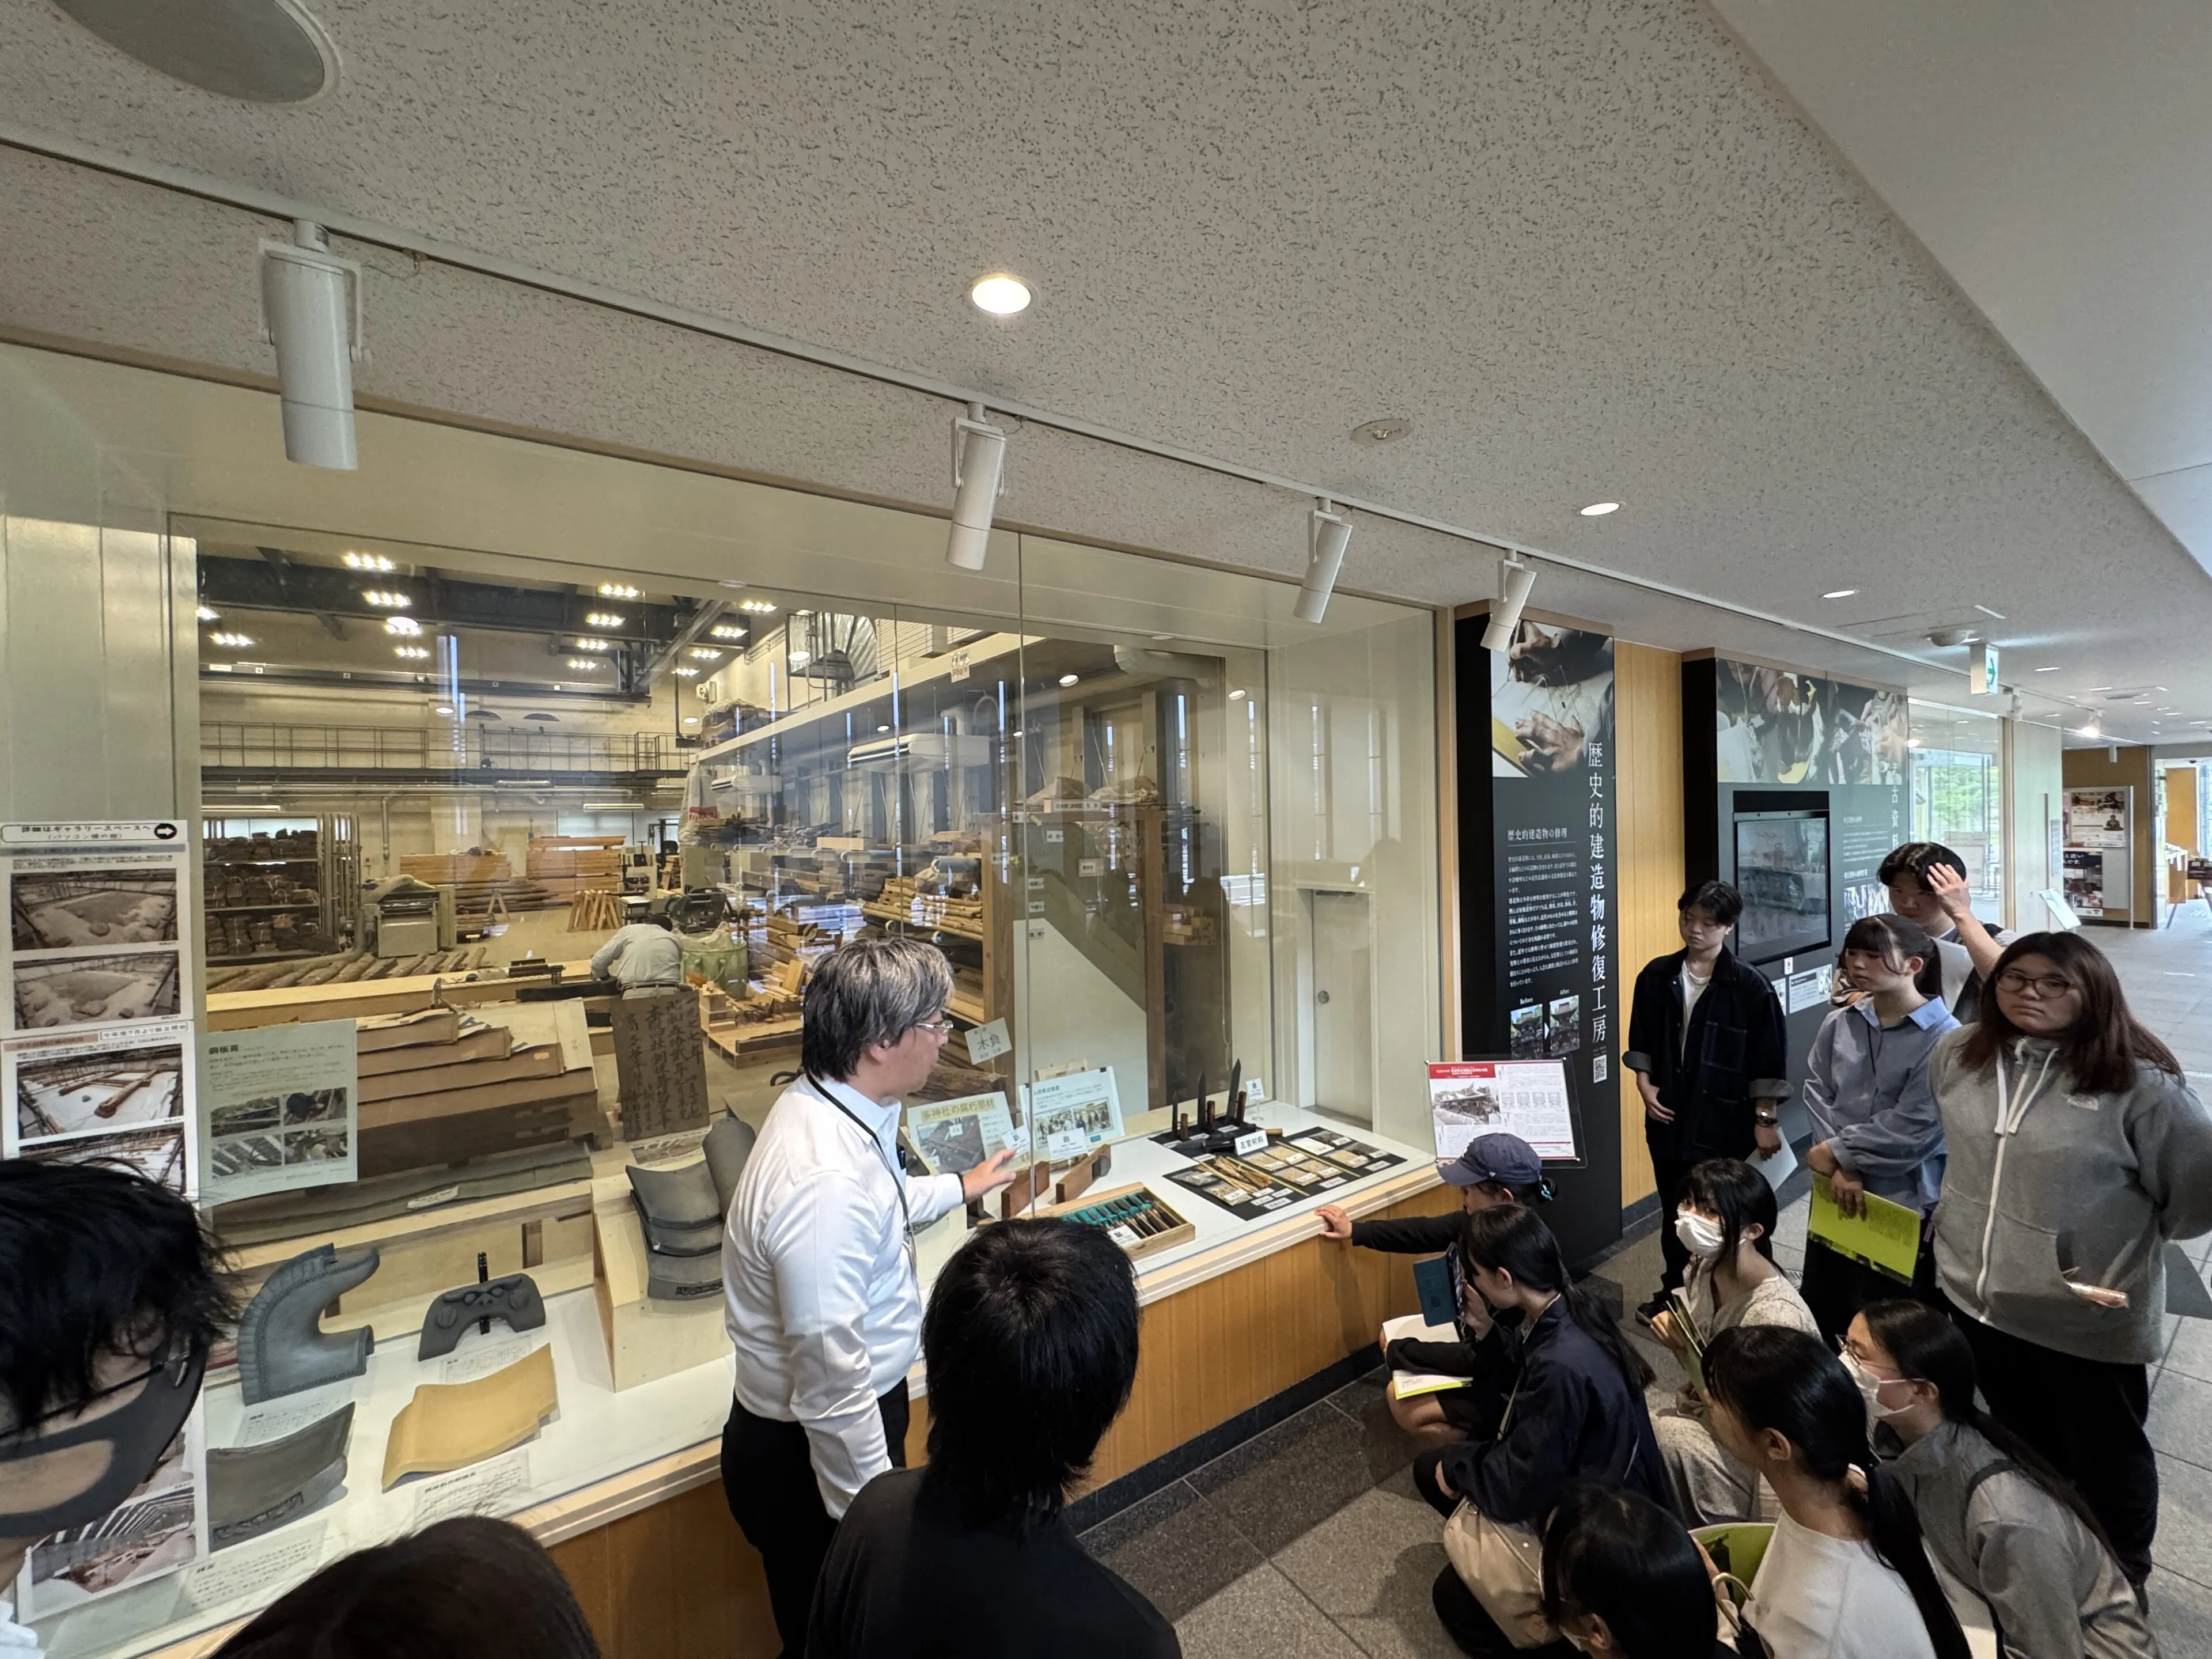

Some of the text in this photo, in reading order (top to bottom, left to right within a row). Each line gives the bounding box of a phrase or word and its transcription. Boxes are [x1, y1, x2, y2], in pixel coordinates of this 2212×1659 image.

[21, 825, 151, 833] 詳細はギャラリースペースへ
[1508, 827, 1567, 841] 歴史的建造物の修理
[1588, 742, 1607, 1043] 歴史的建造物修復工房
[977, 1034, 1002, 1050] 木負
[1240, 1136, 1264, 1149] 左官材料
